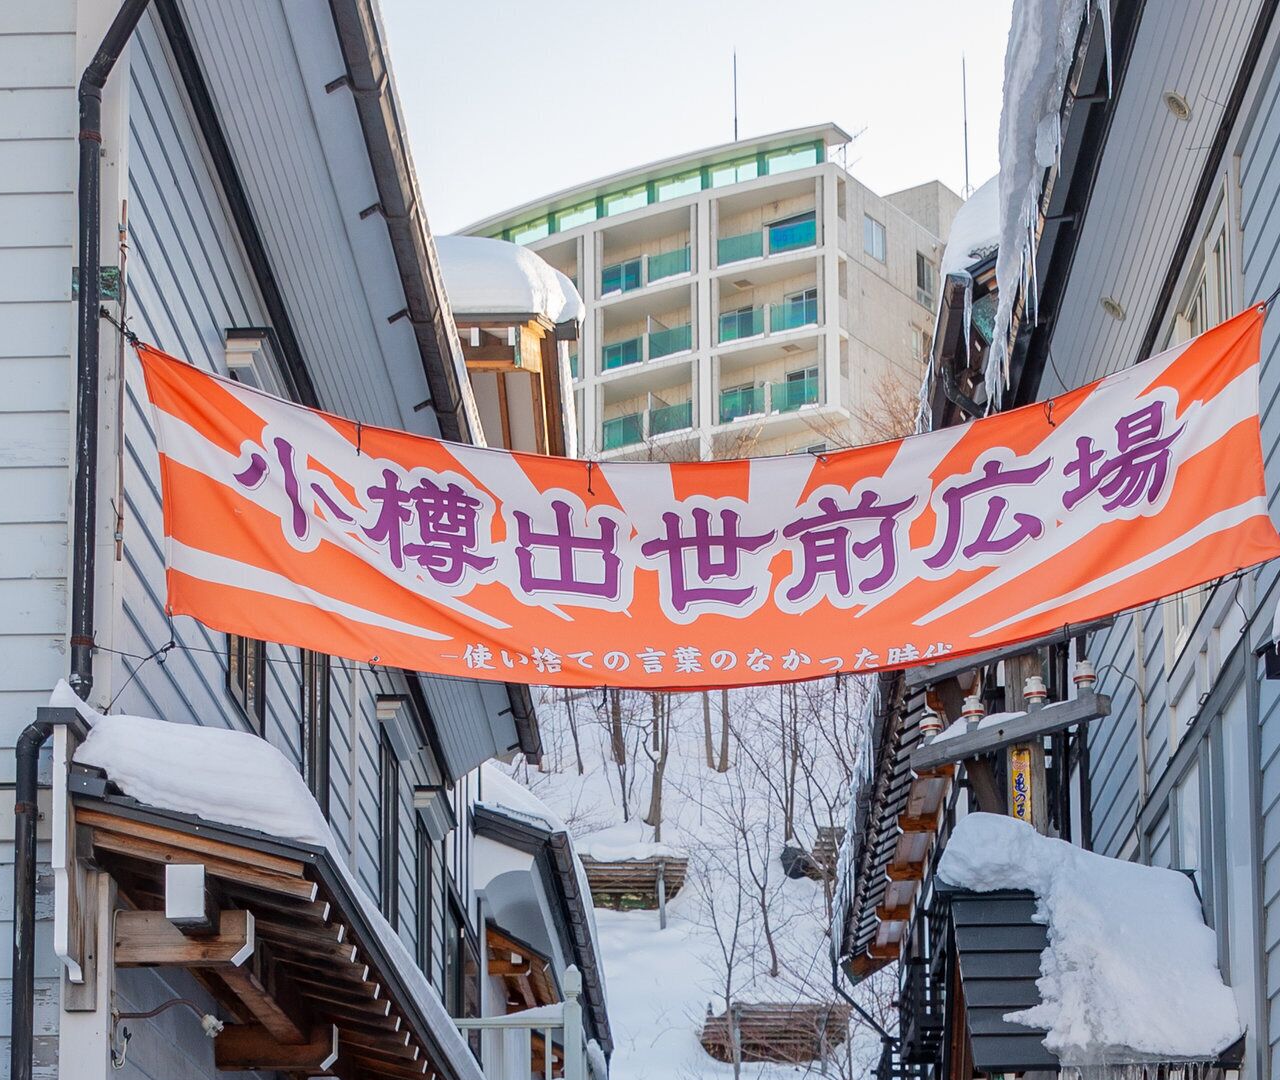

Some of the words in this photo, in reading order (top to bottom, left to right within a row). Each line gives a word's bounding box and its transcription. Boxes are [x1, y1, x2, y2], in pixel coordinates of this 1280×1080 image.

[232, 399, 1188, 608] 小樽出世前広場
